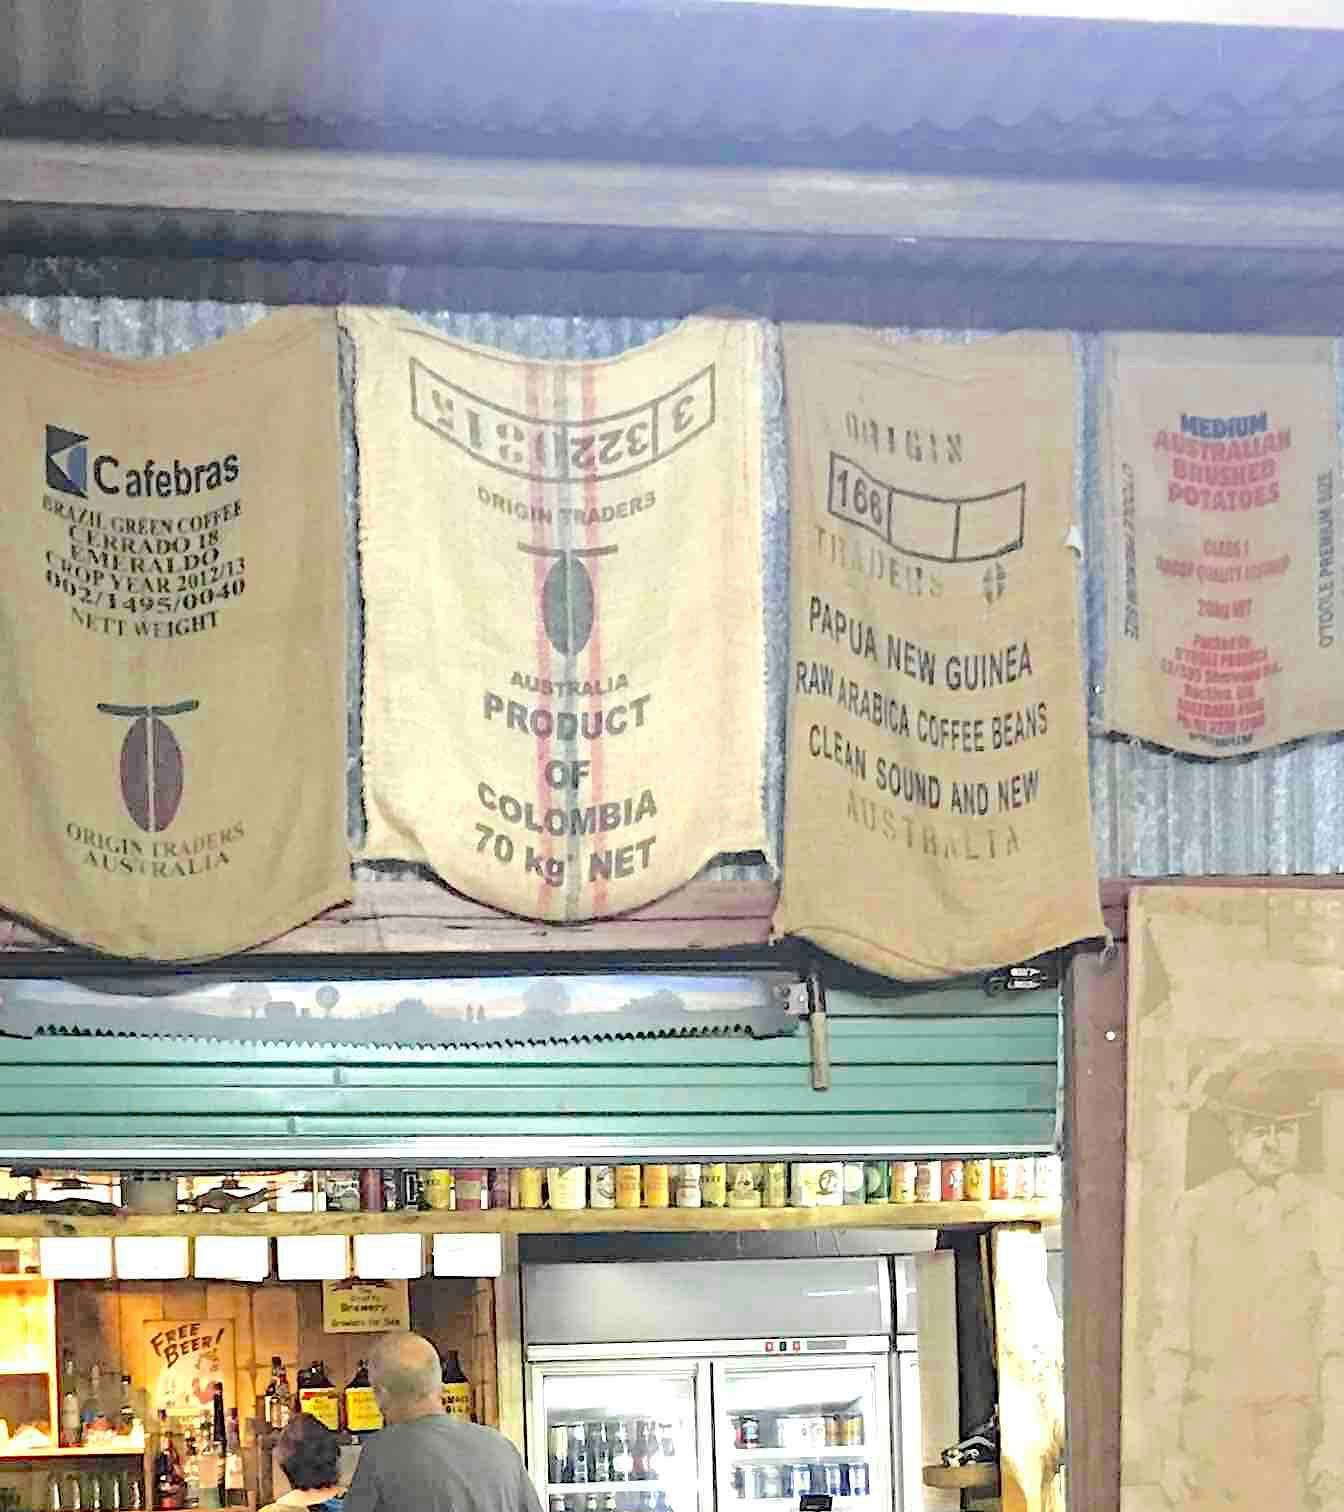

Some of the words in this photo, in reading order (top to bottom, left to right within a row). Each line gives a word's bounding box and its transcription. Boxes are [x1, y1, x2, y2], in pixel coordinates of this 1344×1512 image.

[1180, 411, 1268, 438] MEDIUM
[1154, 429, 1291, 461] AUSTRALIAN
[93, 453, 240, 498] Cafebras
[1173, 458, 1276, 487] BRUSHED
[42, 495, 102, 529] BRAZIL
[111, 516, 173, 536] GREEN
[177, 498, 241, 532] COFFEE
[477, 485, 553, 524] ORIGIN
[557, 490, 656, 526] TRADERS
[1168, 482, 1280, 511] POTATOES
[68, 525, 190, 555] CERRADO
[70, 544, 219, 574] EMERALDO
[45, 550, 104, 585] CROP
[111, 573, 171, 594] YEAR
[71, 607, 129, 637] NETT
[135, 610, 218, 639] WEIGHT
[809, 596, 878, 662] PAPUA
[886, 634, 936, 687] NEW
[945, 640, 1033, 690] GUINEA
[509, 671, 630, 697] AUSTRALIA
[482, 690, 651, 741] PRODUCT
[795, 660, 833, 696] RAW
[836, 677, 910, 738] ARABICA
[917, 710, 985, 752] COFFEE
[991, 701, 1048, 750] BEANS
[544, 759, 592, 789] OF
[808, 724, 866, 781] CLEAN
[876, 756, 941, 809] SOUND
[950, 782, 988, 816] AND
[997, 768, 1040, 812] NEW
[477, 781, 658, 836] COLOMBIA
[846, 790, 1021, 861] AUSTRALIA
[66, 821, 143, 857] ORIGIN
[152, 819, 246, 858] TRADERS
[475, 822, 514, 864] 70
[588, 835, 657, 883] NET
[83, 850, 230, 878] AUSTRALIA
[150, 1323, 201, 1357] FREE
